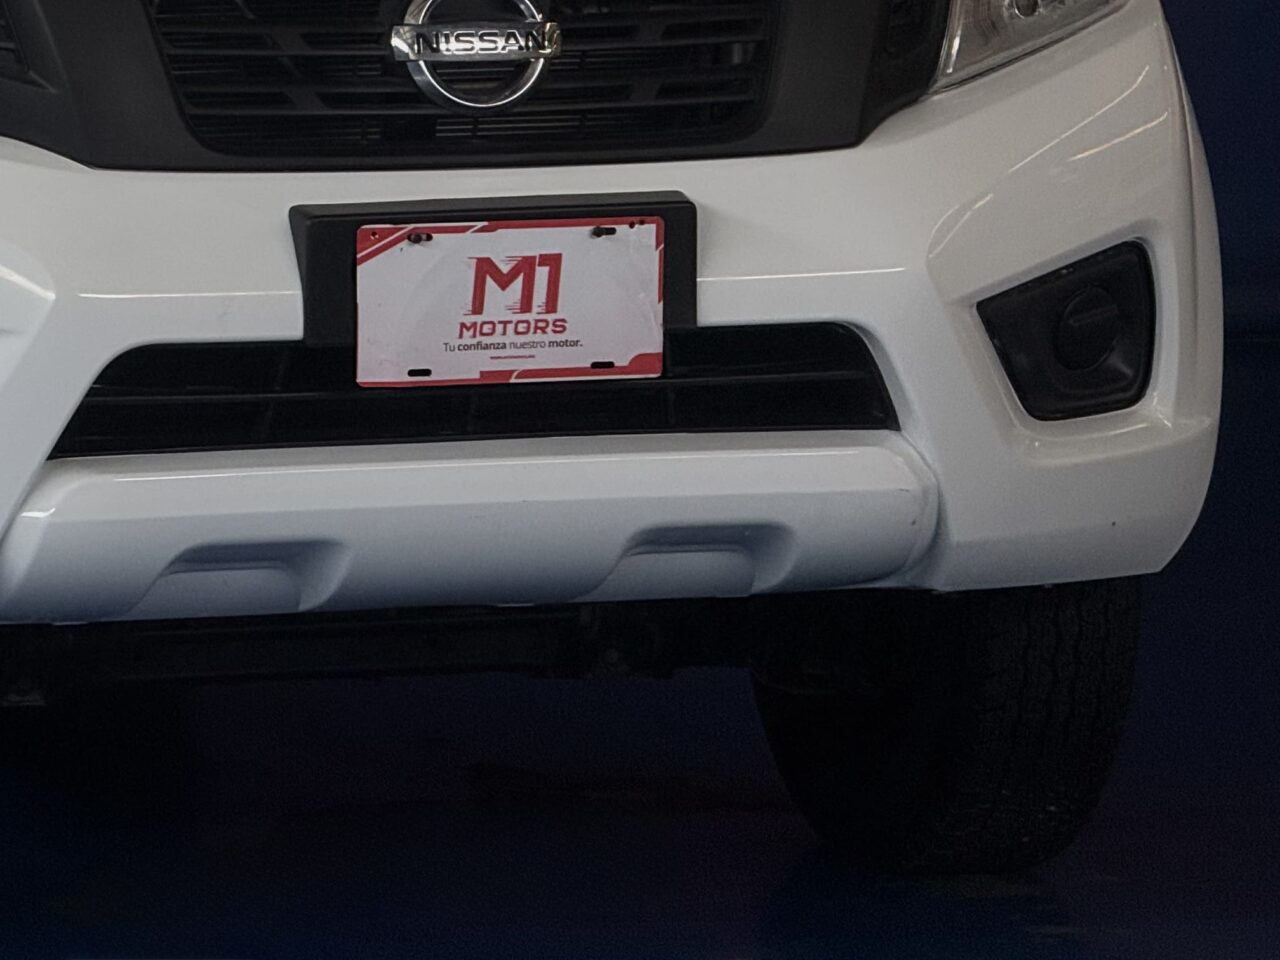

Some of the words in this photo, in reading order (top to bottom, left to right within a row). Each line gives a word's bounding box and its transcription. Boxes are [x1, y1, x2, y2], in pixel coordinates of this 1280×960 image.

[413, 29, 549, 54] NISSAN
[463, 253, 562, 316] M1
[458, 318, 568, 339] MOTORS
[443, 342, 456, 352] Tu
[457, 341, 507, 352] confianza
[509, 340, 546, 351] nuestro
[548, 339, 583, 349] motor.
